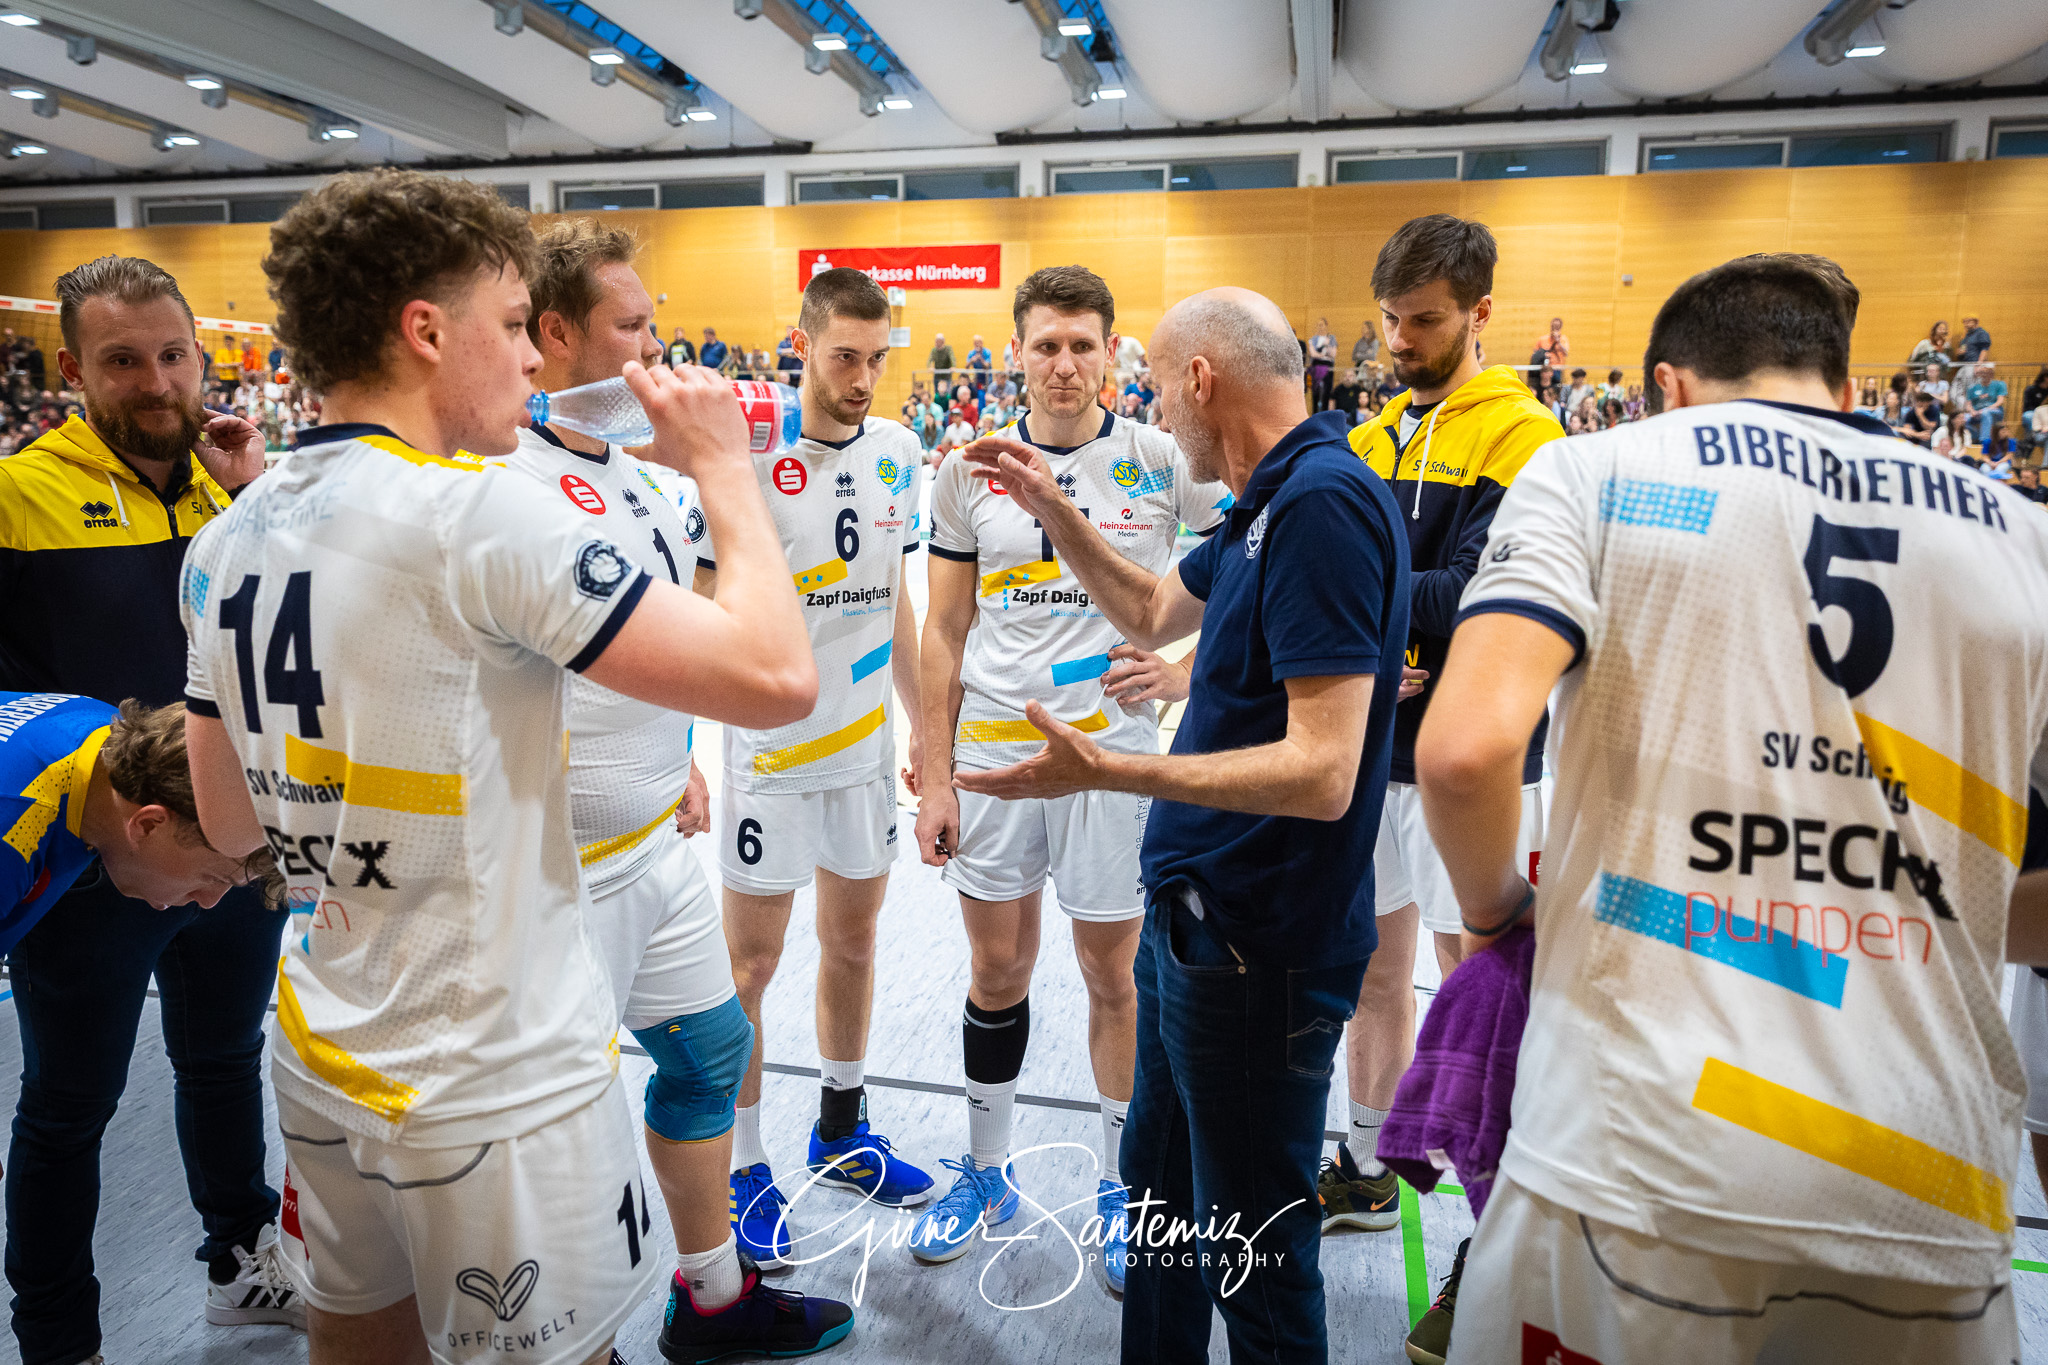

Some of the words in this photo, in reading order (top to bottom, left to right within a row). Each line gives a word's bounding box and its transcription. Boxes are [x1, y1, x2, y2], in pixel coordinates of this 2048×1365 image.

[915, 263, 986, 282] Nürnberg
[835, 488, 856, 497] errea
[1693, 423, 2007, 532] BIBELRIETHER
[83, 518, 118, 528] errea
[632, 506, 650, 518] errea
[1099, 521, 1153, 531] Heinzelmann
[835, 508, 860, 562] 6
[806, 592, 841, 608] Zapf
[842, 587, 891, 604] Daigfuss
[1012, 588, 1048, 606] Zapf
[1051, 590, 1095, 608] Daig
[1803, 513, 1899, 699] 5
[218, 570, 325, 739] 14
[1762, 731, 1800, 770] SV
[246, 767, 270, 796] SV
[737, 817, 763, 866] 6
[1685, 891, 1932, 968] pumpen
[447, 1308, 577, 1352] OFFICEWELT
